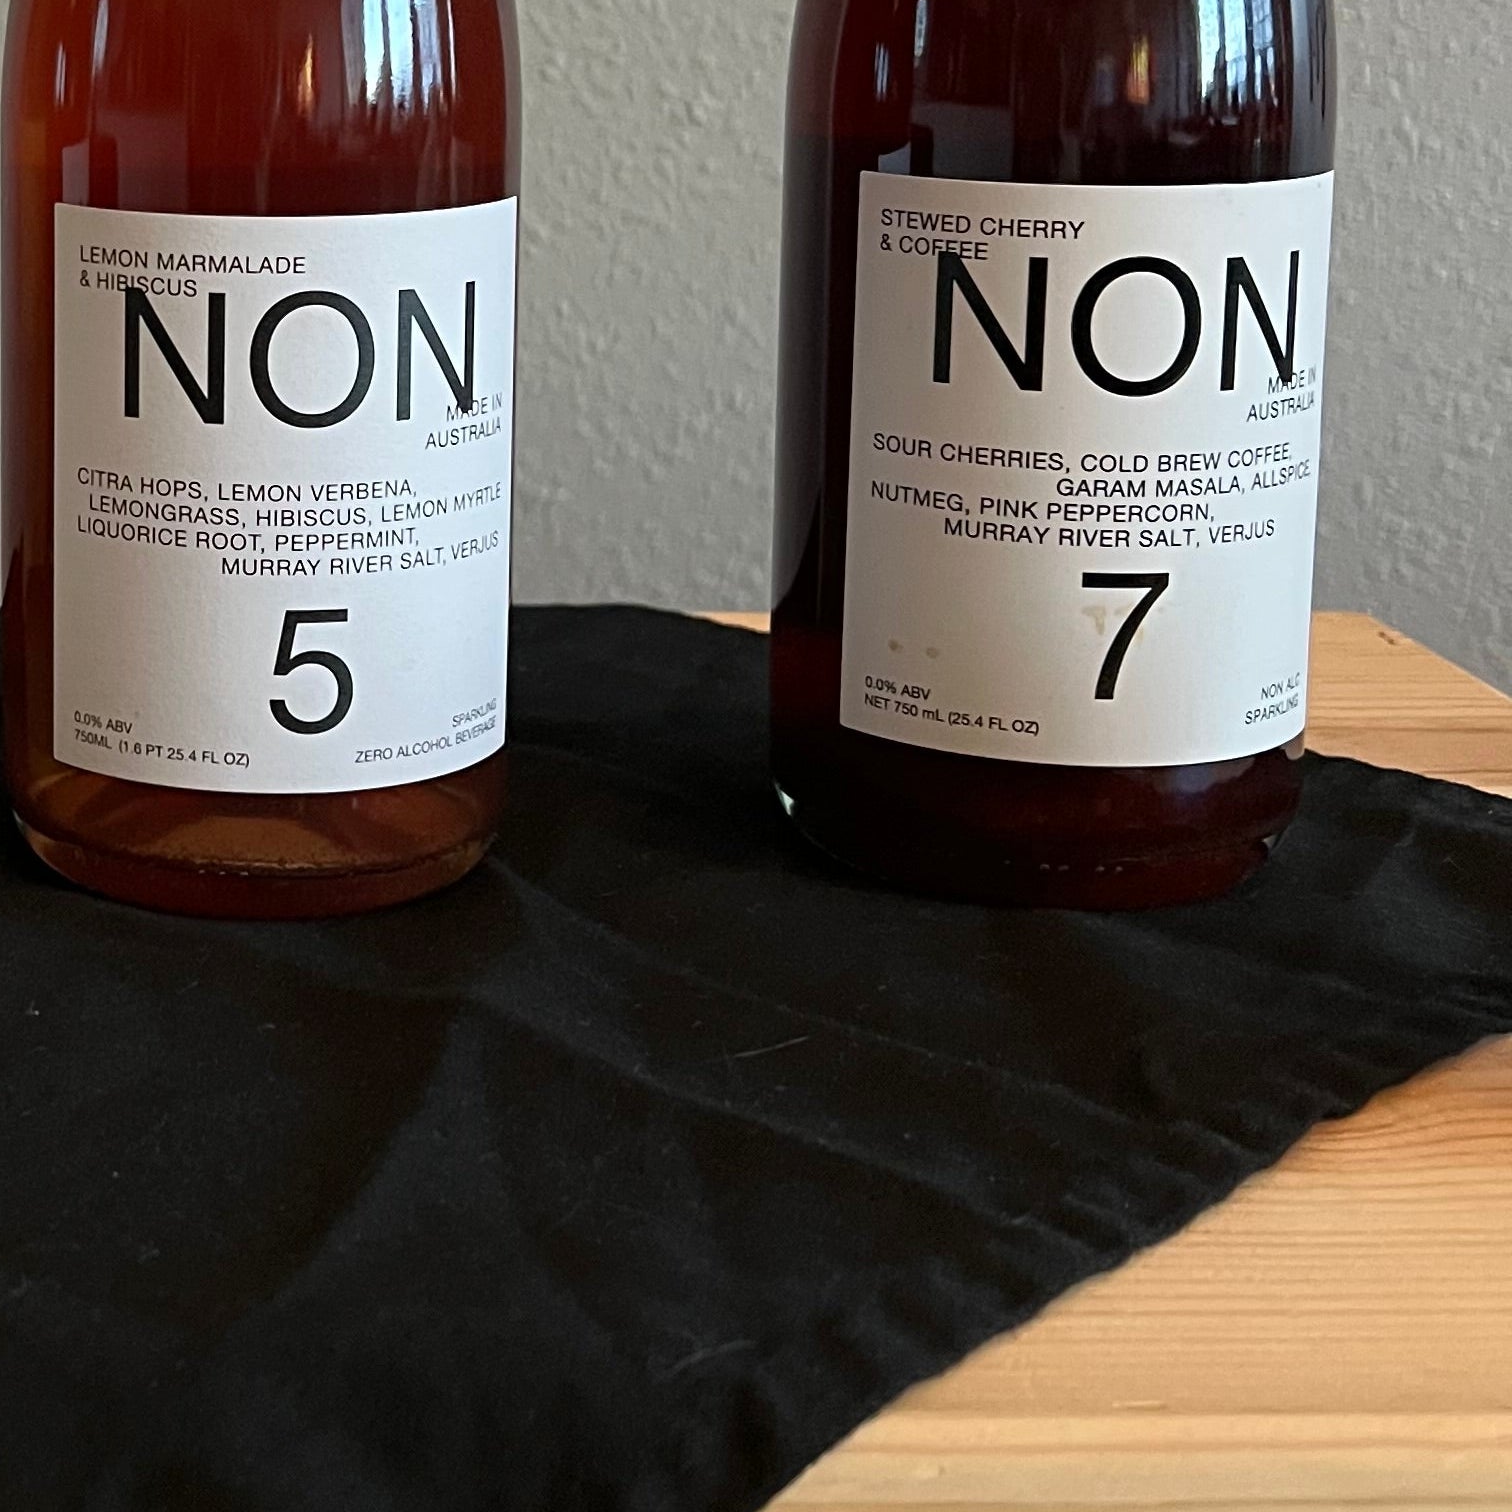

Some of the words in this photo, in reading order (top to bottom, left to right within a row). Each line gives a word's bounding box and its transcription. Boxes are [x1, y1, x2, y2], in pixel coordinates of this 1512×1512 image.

[881, 208, 971, 234] STEWED
[980, 217, 1085, 240] CHERRY
[80, 244, 148, 269] LEMON
[157, 252, 306, 274] MARMALADE
[880, 233, 892, 252] &
[899, 236, 988, 261] COFFEE
[79, 269, 91, 287] &
[97, 272, 198, 297] HIBISCUS
[933, 250, 1300, 398] NON
[124, 281, 476, 428] NON
[425, 416, 502, 450] AUSTRALIA
[873, 433, 932, 458] SOUR
[940, 443, 1070, 473] CHERRIES,
[1081, 454, 1149, 473] COLD
[1158, 452, 1222, 472] BREW
[77, 467, 134, 492] CITRA
[140, 477, 208, 502] HOPS,
[218, 483, 301, 502] LEMON
[311, 479, 417, 502] VERBENA,
[872, 480, 970, 515] NUTMEG,
[980, 497, 1038, 519] PINK
[1047, 502, 1215, 523] PEPPERCORN,
[1056, 478, 1146, 497] GARAM
[1156, 476, 1245, 497] MASALA,
[89, 494, 246, 529] LEMONGRASS,
[256, 507, 372, 527] HIBISCUS,
[382, 497, 448, 523] LEMON
[453, 481, 501, 512] MYRTLE
[77, 515, 188, 548] LIQUORICE
[196, 531, 265, 554] ROOT,
[275, 527, 419, 552] PEPPERMINT,
[944, 517, 1050, 544] MURRAY
[1059, 528, 1130, 547] RIVER
[1139, 528, 1200, 548] SALT,
[1209, 519, 1275, 544] VERJUS
[221, 557, 320, 576] MURRAY
[330, 555, 392, 575] RIVER
[400, 546, 447, 570] SALT,
[451, 530, 499, 560] VERJUS
[1082, 572, 1170, 700] 7
[269, 608, 354, 735] 5
[865, 675, 897, 694] 0.0%
[900, 684, 931, 700] ABV
[1261, 680, 1283, 700] NON
[74, 710, 102, 728] 0.0%
[106, 718, 133, 734] ABV
[864, 693, 891, 710] NET
[894, 700, 918, 717] 750
[922, 708, 944, 723] mL
[948, 711, 984, 728] (25.4
[988, 716, 1008, 731] FL
[1012, 719, 1040, 737] OZ)
[74, 729, 112, 750] 750ML
[146, 744, 163, 758] PT
[201, 751, 219, 764] FL
[224, 752, 250, 768] OZ)
[355, 747, 393, 763] ZERO
[396, 735, 452, 759] ALCOHOL
